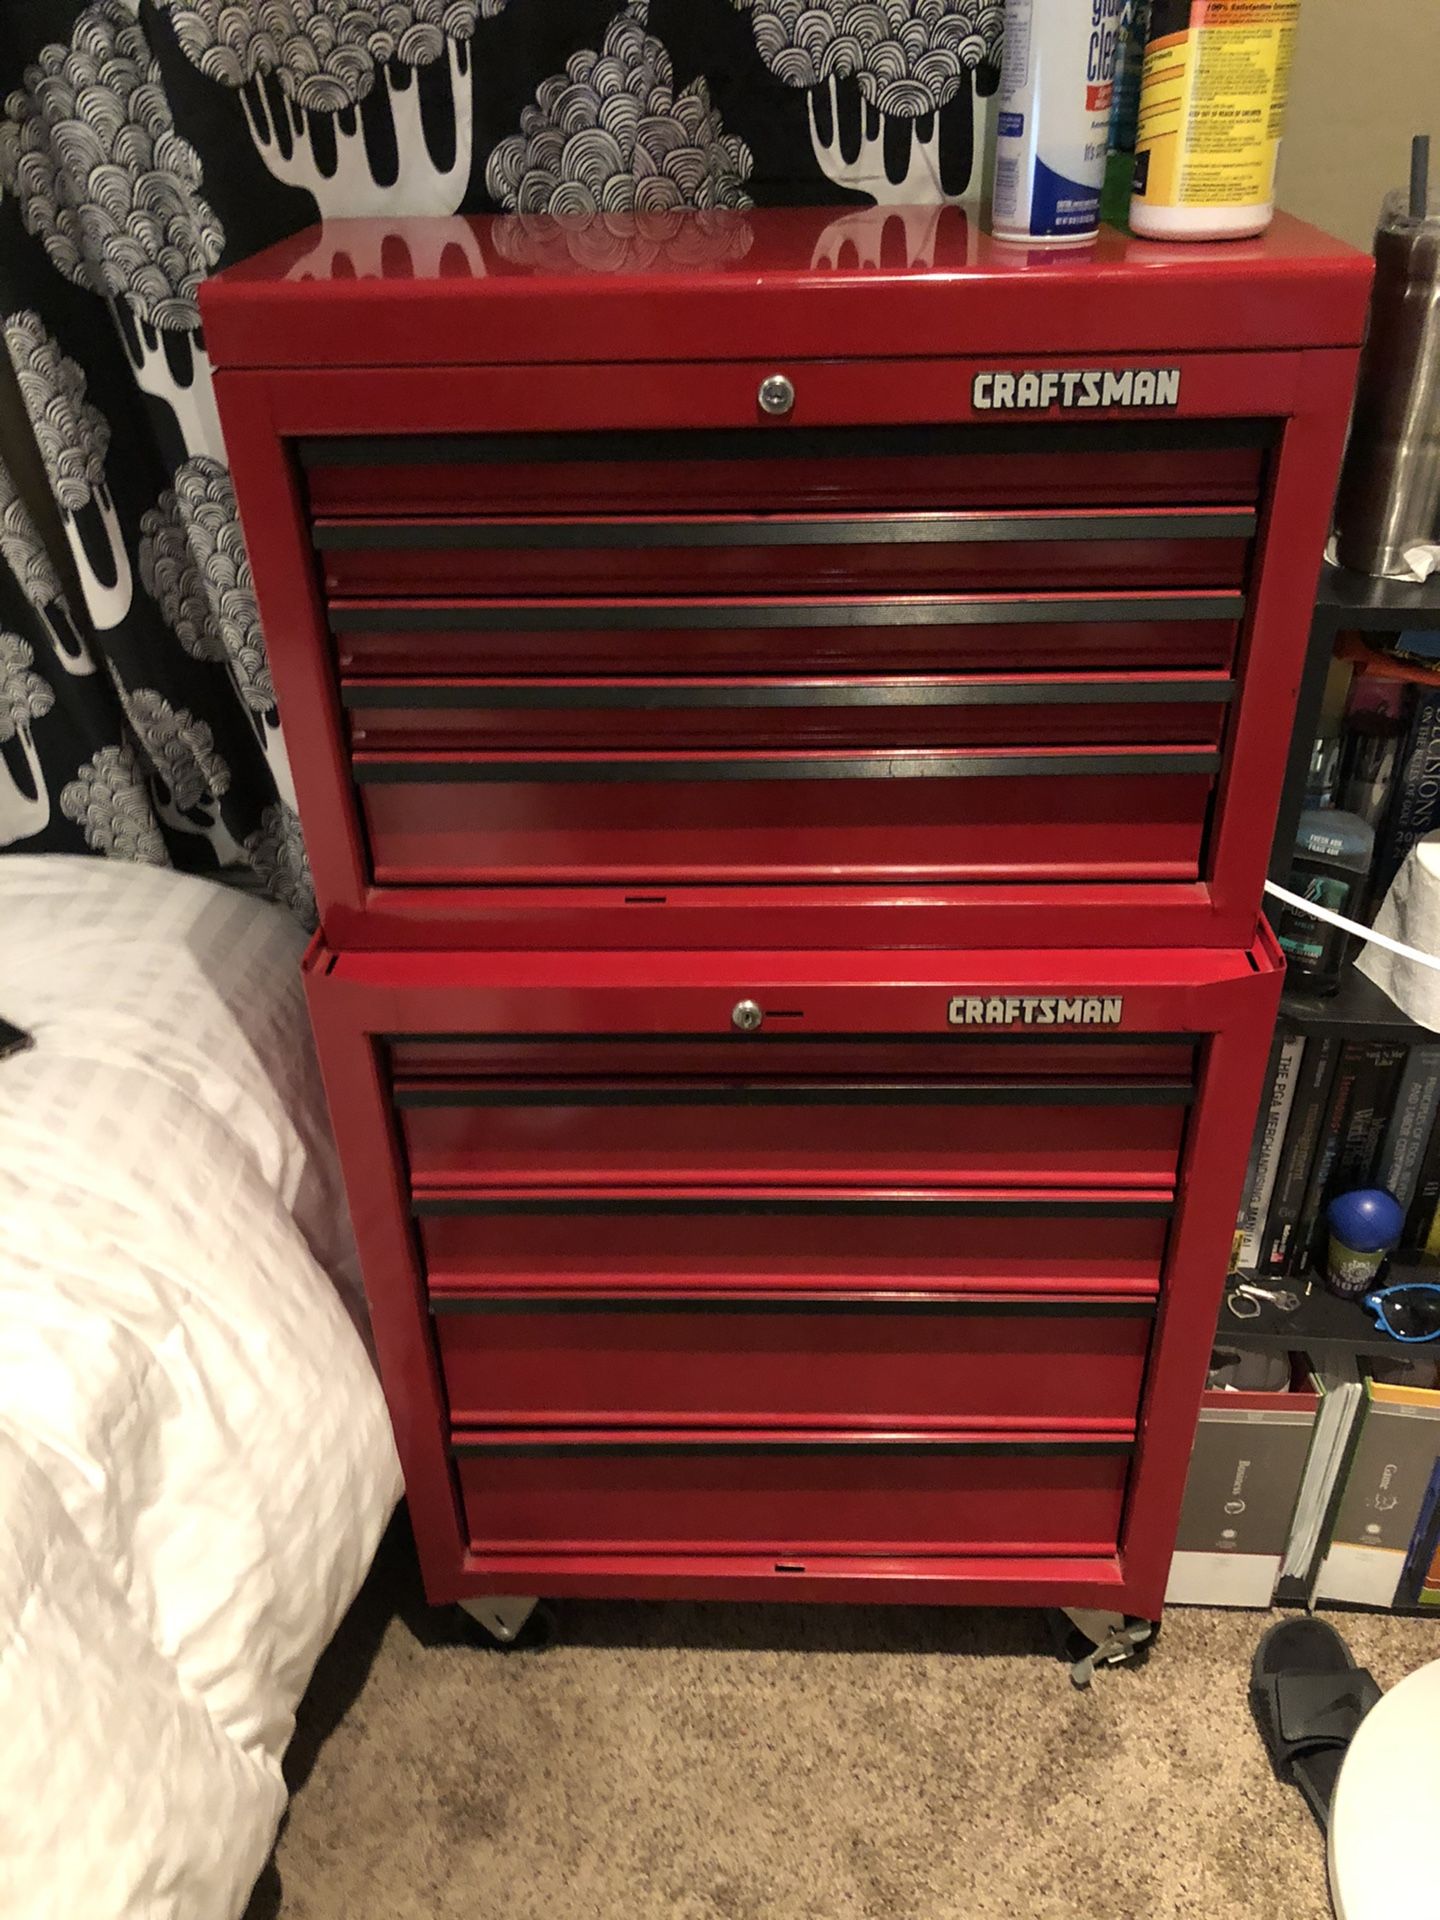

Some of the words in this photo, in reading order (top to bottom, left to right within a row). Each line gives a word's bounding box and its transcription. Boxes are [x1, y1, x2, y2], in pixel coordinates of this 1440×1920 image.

[973, 369, 1181, 410] CRAFTSMAN
[1416, 726, 1429, 746] THE
[949, 997, 1123, 1024] CRAFTSMAN
[1278, 1056, 1293, 1079] THE
[1270, 1083, 1286, 1108] PGA
[1251, 1111, 1280, 1203] MERCHANDISING
[1242, 1207, 1259, 1247] MANUAL
[1232, 1460, 1251, 1495] Business
